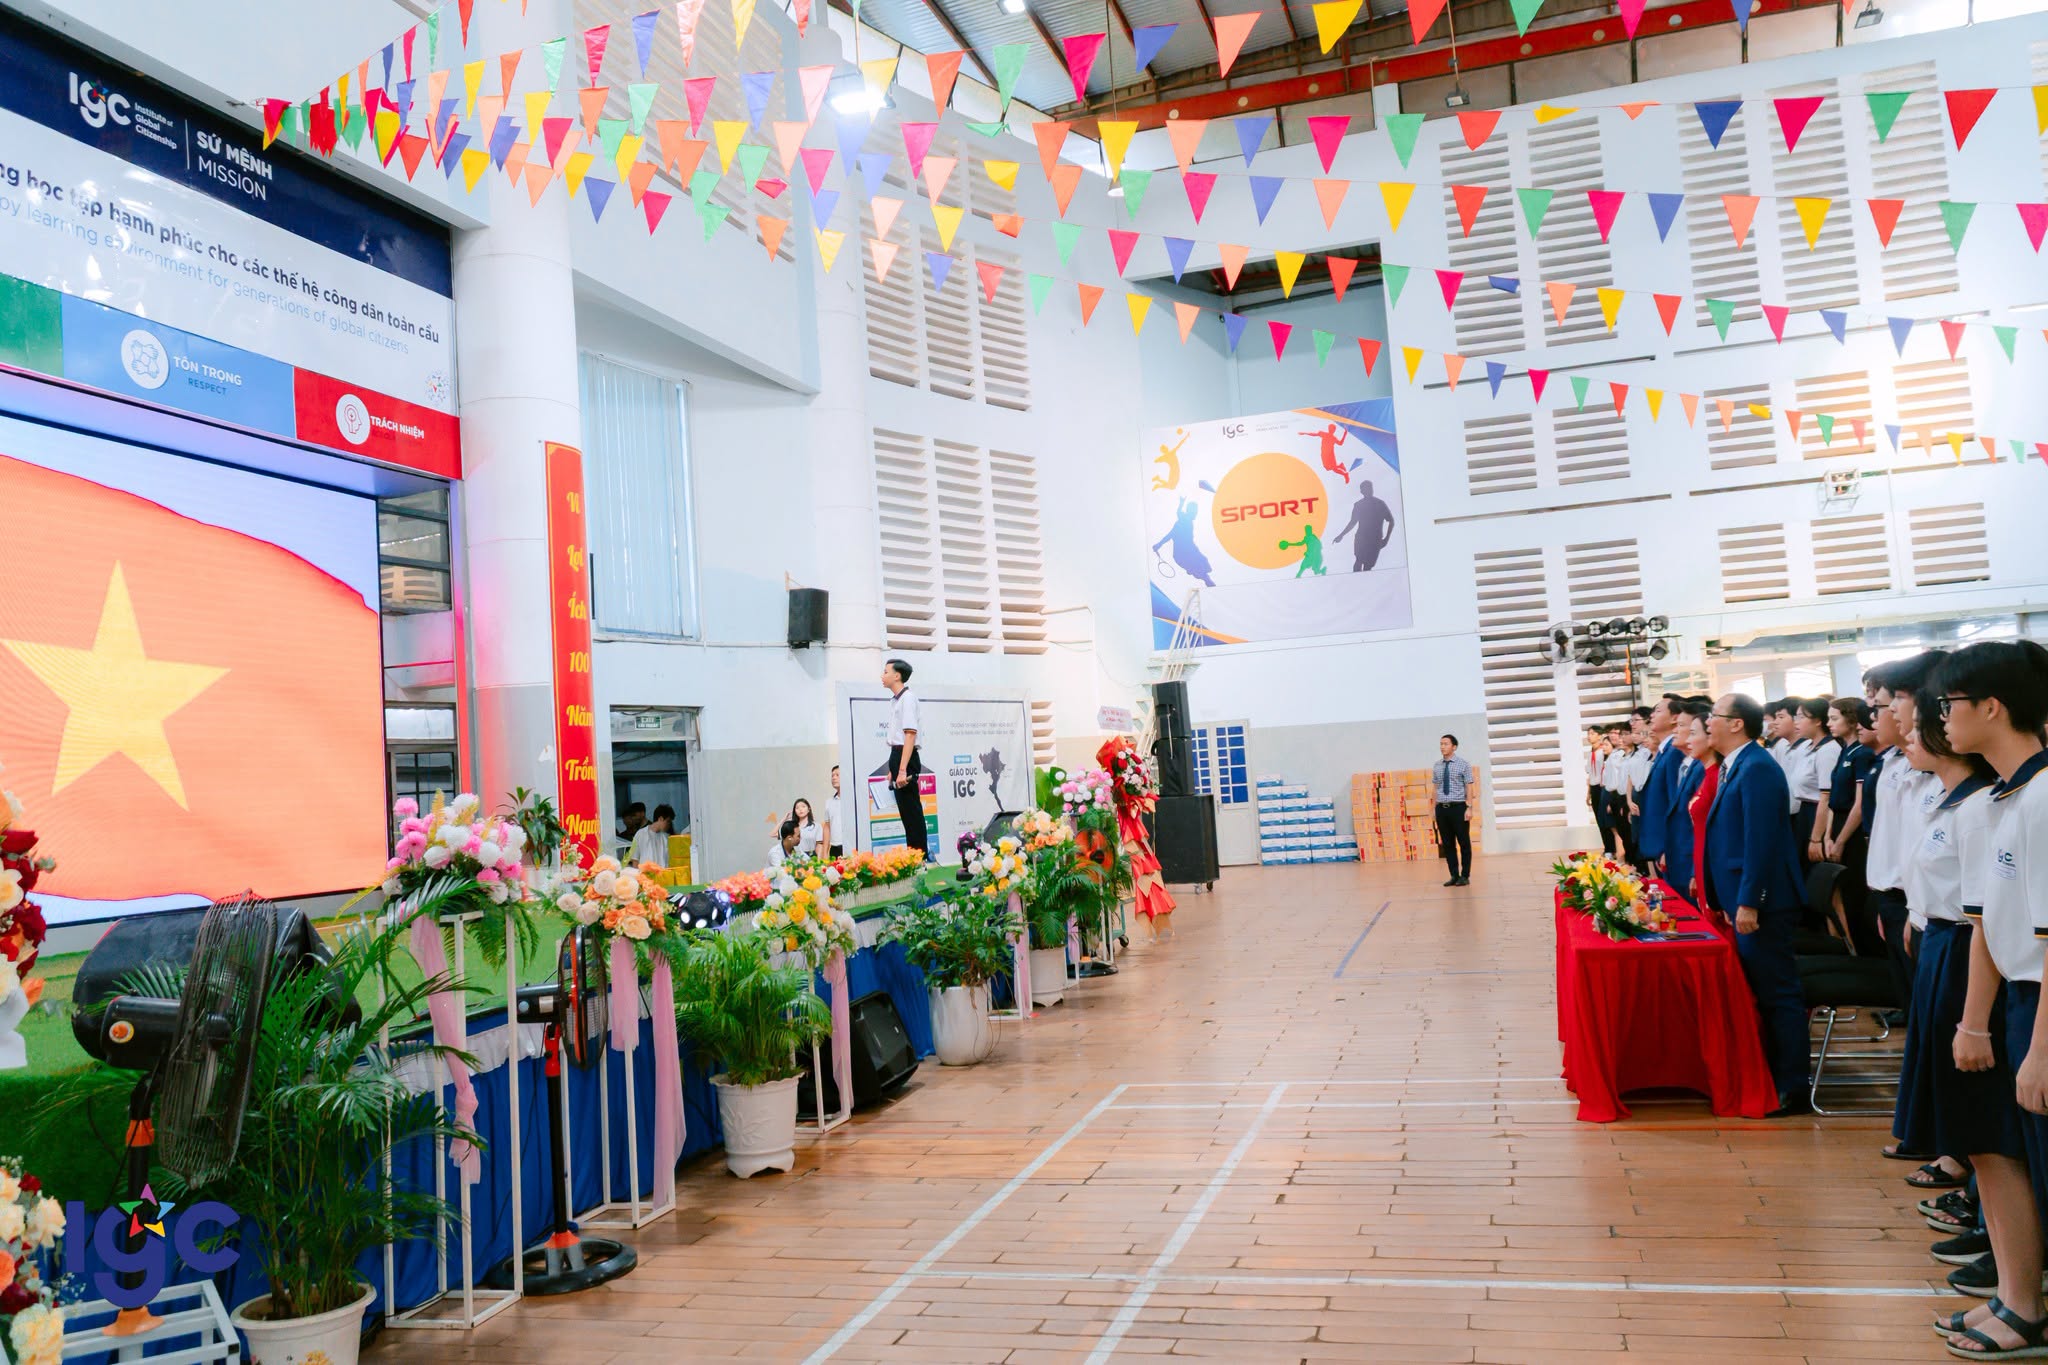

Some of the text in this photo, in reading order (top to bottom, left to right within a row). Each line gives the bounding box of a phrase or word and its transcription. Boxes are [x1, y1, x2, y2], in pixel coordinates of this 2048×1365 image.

[134, 102, 174, 128] Institute of
[135, 114, 161, 132] Global
[135, 124, 178, 150] Citizenship
[196, 130, 273, 181] SỨ MỆNH
[199, 155, 266, 201] MISSION
[27, 169, 64, 201] học
[109, 202, 154, 236] hạnh
[209, 243, 238, 267] cho
[243, 258, 269, 280] các
[273, 267, 300, 290] thế
[302, 277, 320, 302] hệ
[323, 288, 357, 315] công
[361, 300, 385, 323] dân
[387, 310, 415, 336] toàn
[418, 323, 440, 344] cầu
[27, 202, 98, 246] learning
[104, 234, 204, 281] environment
[208, 268, 230, 290] for
[232, 281, 311, 319] generations
[314, 308, 327, 324] of
[329, 315, 366, 339] global
[368, 330, 409, 354] citizens
[173, 352, 242, 387] TÔN TRỌNG
[188, 377, 227, 396] RESPECT
[370, 415, 398, 431] TRÁCH
[399, 424, 425, 439] NHIỆM
[1220, 497, 1319, 524] SPORT
[569, 651, 590, 673] 100
[953, 779, 976, 798] IGC
